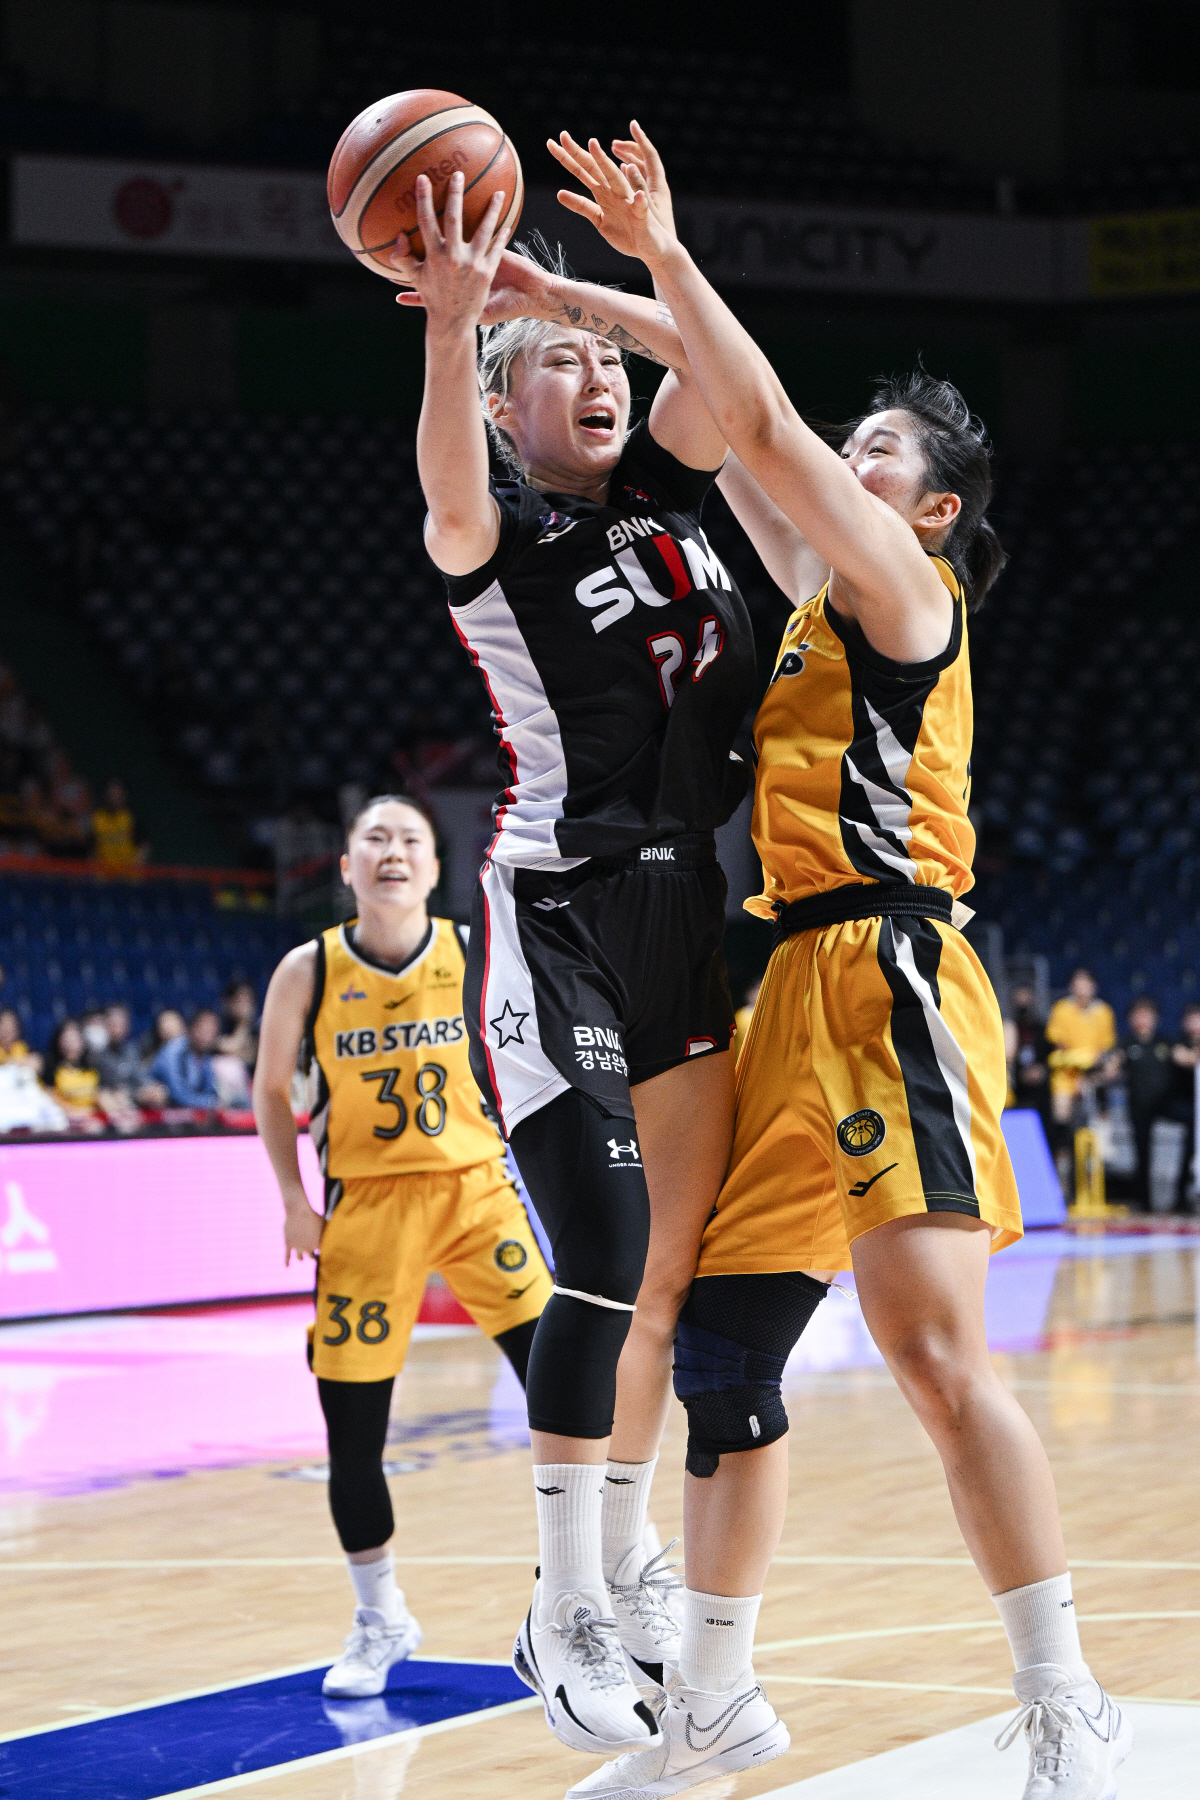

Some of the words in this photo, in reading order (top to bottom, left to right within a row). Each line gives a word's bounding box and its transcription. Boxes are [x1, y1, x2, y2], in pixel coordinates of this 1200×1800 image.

[395, 151, 468, 213] mlten
[606, 516, 665, 551] BNK
[575, 529, 732, 634] SUM
[640, 847, 675, 861] BNK
[335, 1029, 376, 1057] KB
[381, 1016, 463, 1052] STARS
[361, 1062, 447, 1139] 38
[323, 1294, 390, 1346] 38
[715, 1619, 735, 1627] STARS
